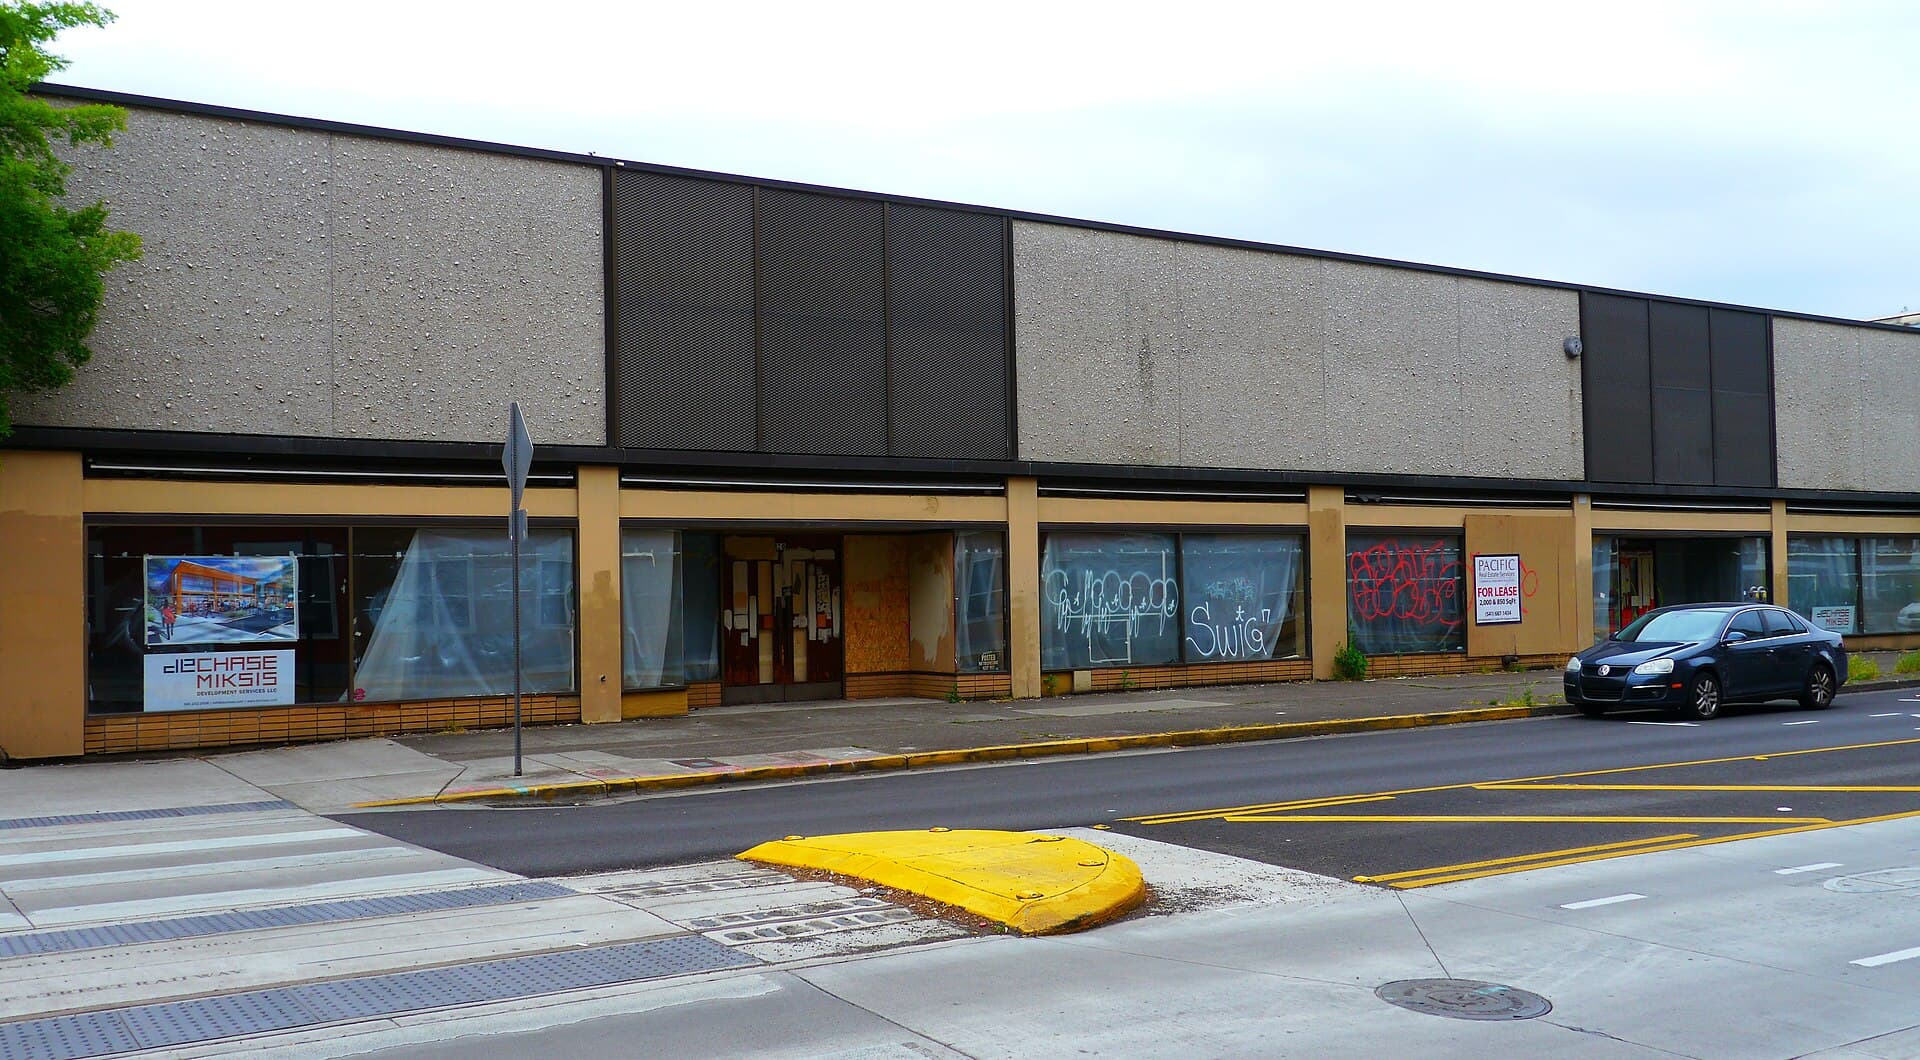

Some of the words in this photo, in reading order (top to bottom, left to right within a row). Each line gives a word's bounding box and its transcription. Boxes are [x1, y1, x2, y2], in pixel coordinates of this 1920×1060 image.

[1479, 559, 1515, 571] PACIFIC
[1478, 588, 1493, 597] FOR
[1495, 587, 1517, 597] LEASE
[197, 672, 277, 688] MIKSIS
